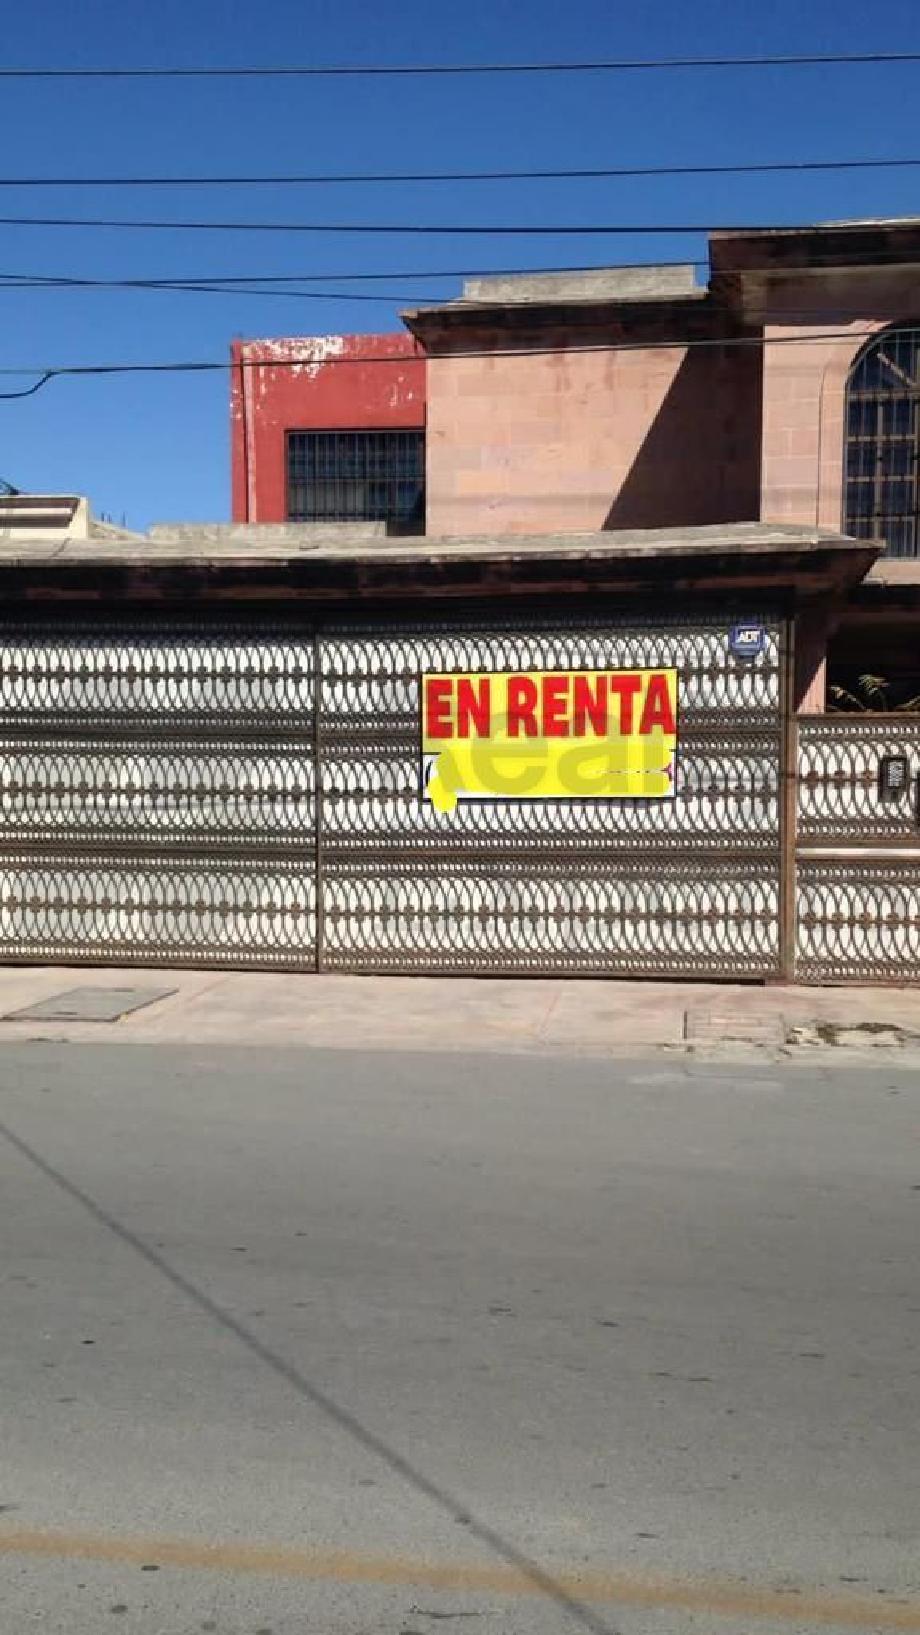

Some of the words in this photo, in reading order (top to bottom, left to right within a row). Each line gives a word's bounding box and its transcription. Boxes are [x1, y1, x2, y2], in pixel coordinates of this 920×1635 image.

[735, 630, 761, 643] ADT
[426, 678, 491, 738] EN
[507, 674, 675, 737] RENTA
